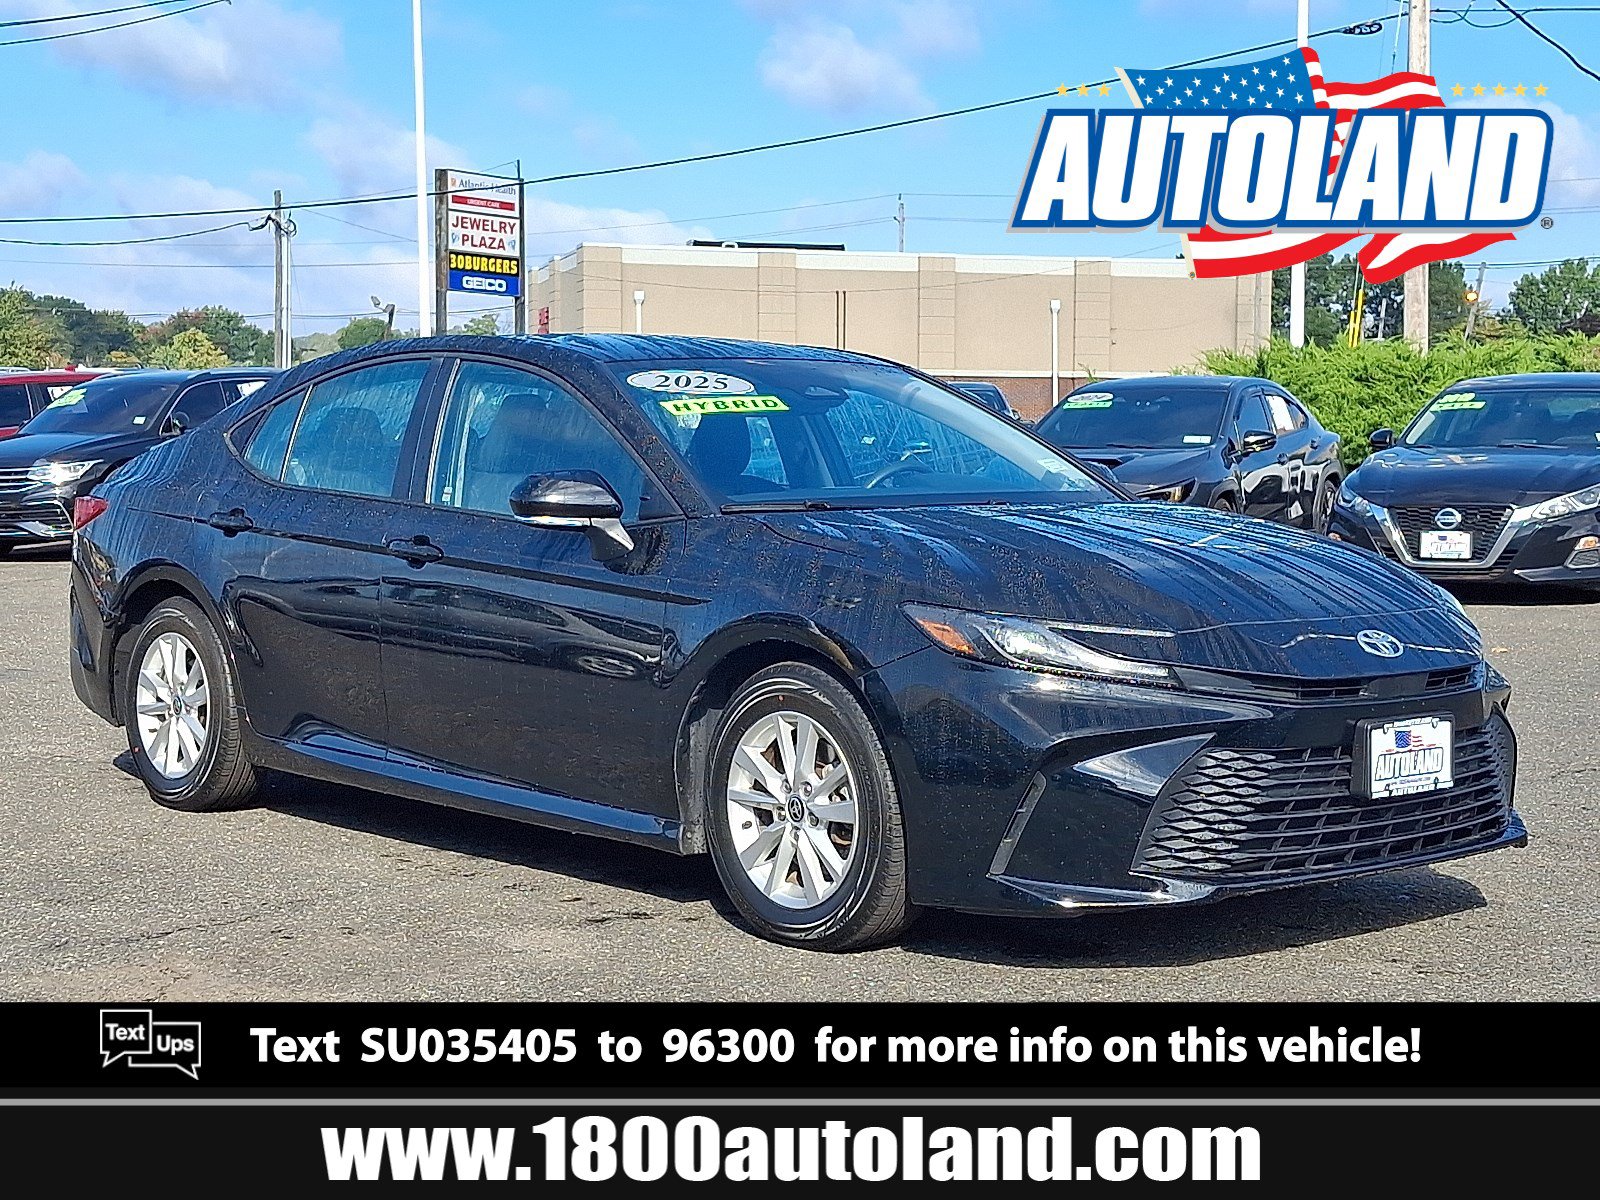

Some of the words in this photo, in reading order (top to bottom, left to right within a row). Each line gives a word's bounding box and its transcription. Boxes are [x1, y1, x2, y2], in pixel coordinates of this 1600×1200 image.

[452, 215, 516, 235] JEWELRY
[461, 233, 506, 250] PLAZA
[462, 275, 507, 292] GEICO
[654, 374, 728, 390] 2025
[672, 398, 779, 412] HYBRID
[1375, 747, 1444, 781] AUTOLAND
